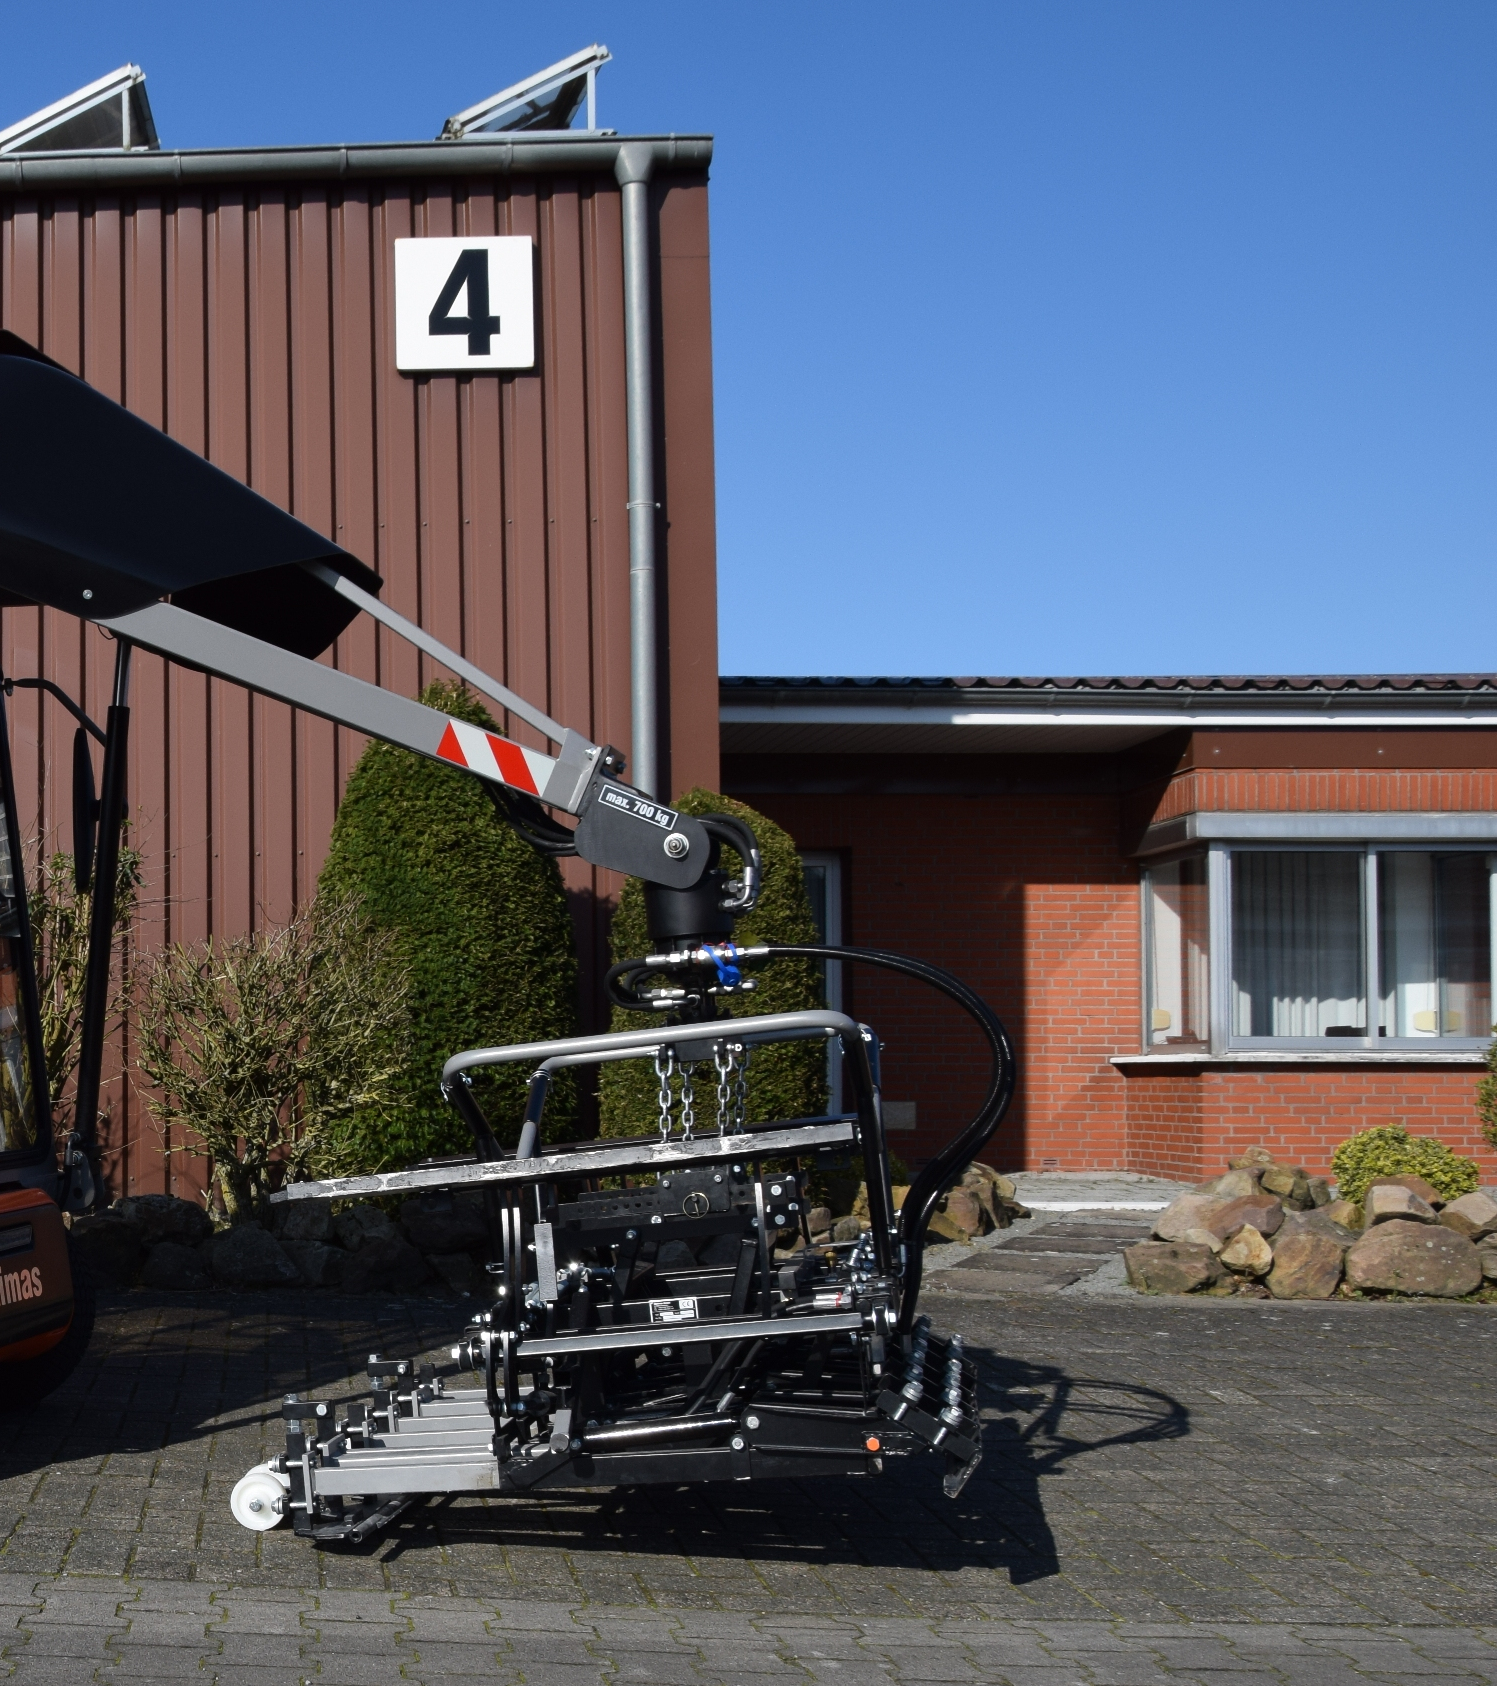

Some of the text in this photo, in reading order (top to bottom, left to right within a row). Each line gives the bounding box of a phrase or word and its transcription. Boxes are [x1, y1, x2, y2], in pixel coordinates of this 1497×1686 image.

[428, 248, 501, 356] 4
[605, 792, 670, 826] max. 700 kg
